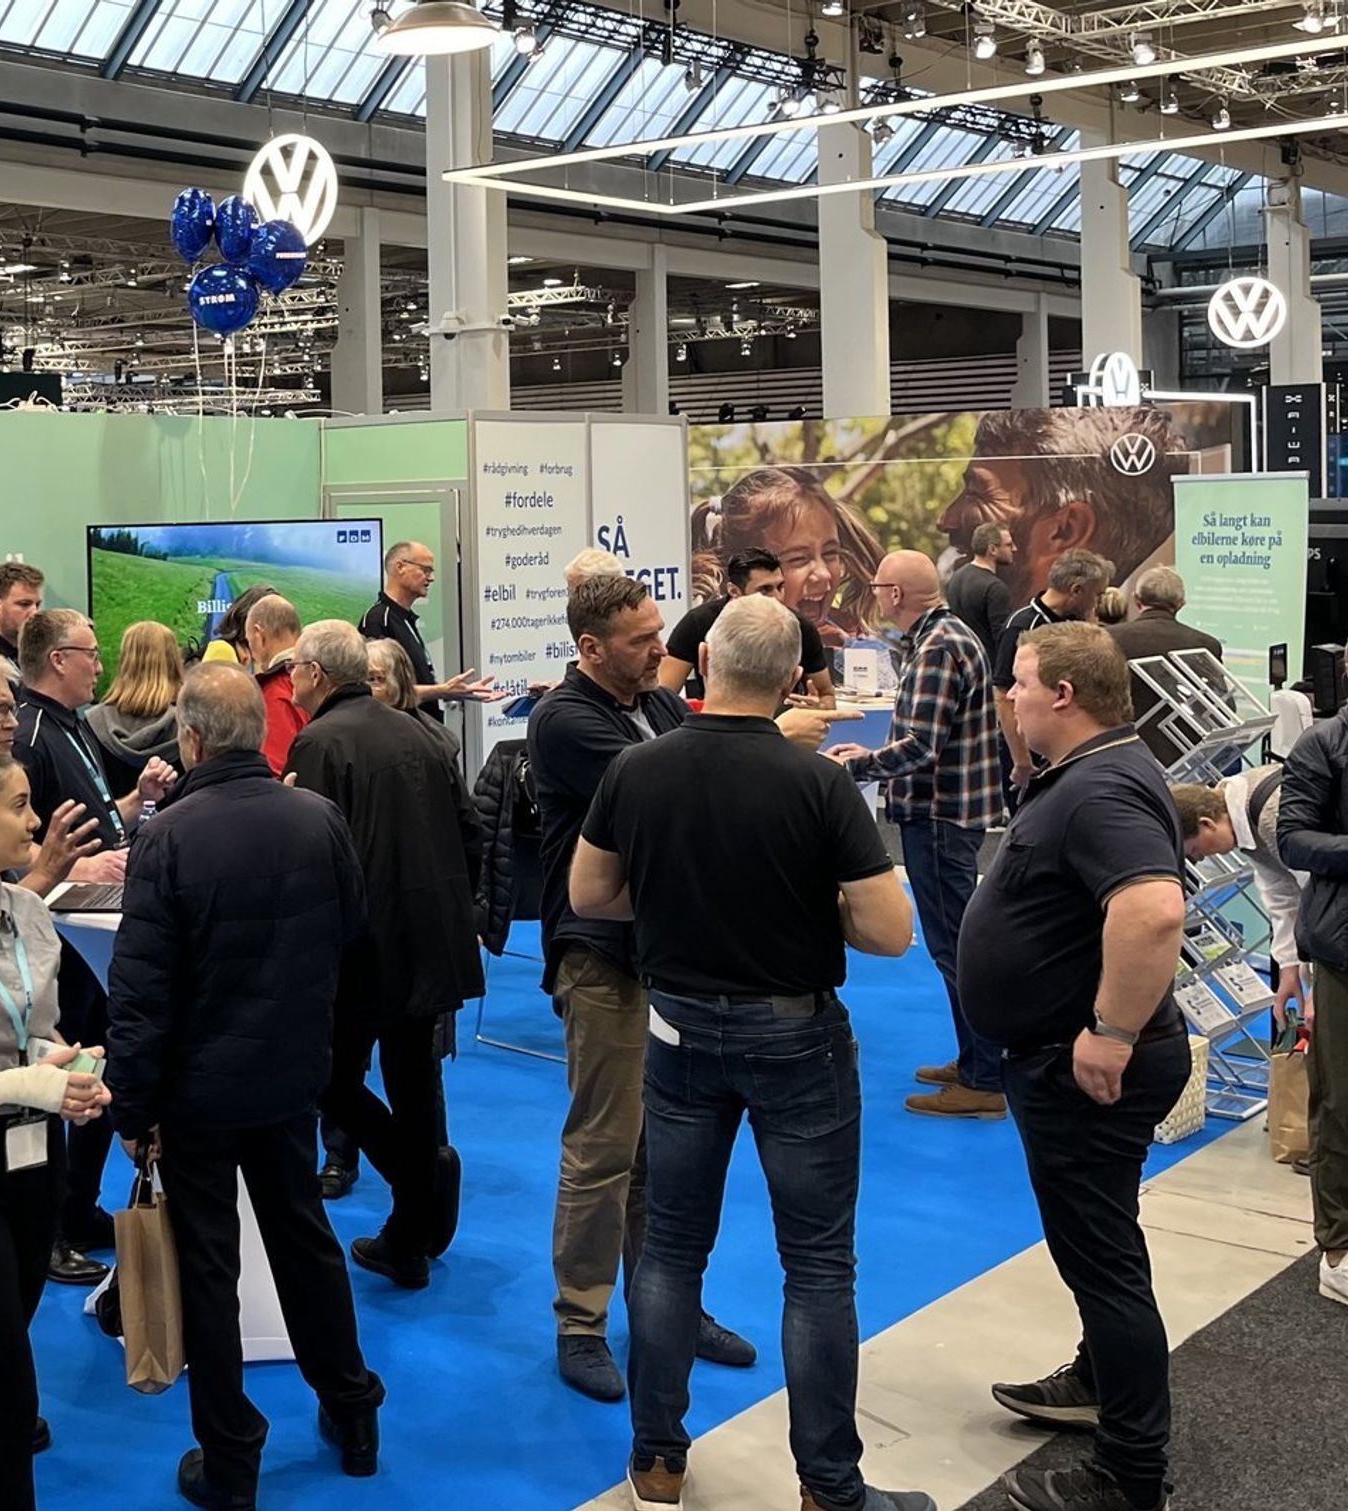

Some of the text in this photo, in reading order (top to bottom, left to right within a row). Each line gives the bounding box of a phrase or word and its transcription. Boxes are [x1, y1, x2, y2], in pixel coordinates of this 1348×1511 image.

[483, 461, 573, 477] #rådgivning #forbrug
[504, 491, 554, 508] #fordele
[1203, 511, 1271, 531] Så langt kan
[486, 523, 562, 539] #tryghedihverdagen
[597, 514, 630, 558] SÅ
[1192, 530, 1283, 550] elbilerne køre på
[505, 551, 549, 570] #goderåd
[1200, 551, 1272, 570] en opladning
[484, 584, 516, 602] #elbil
